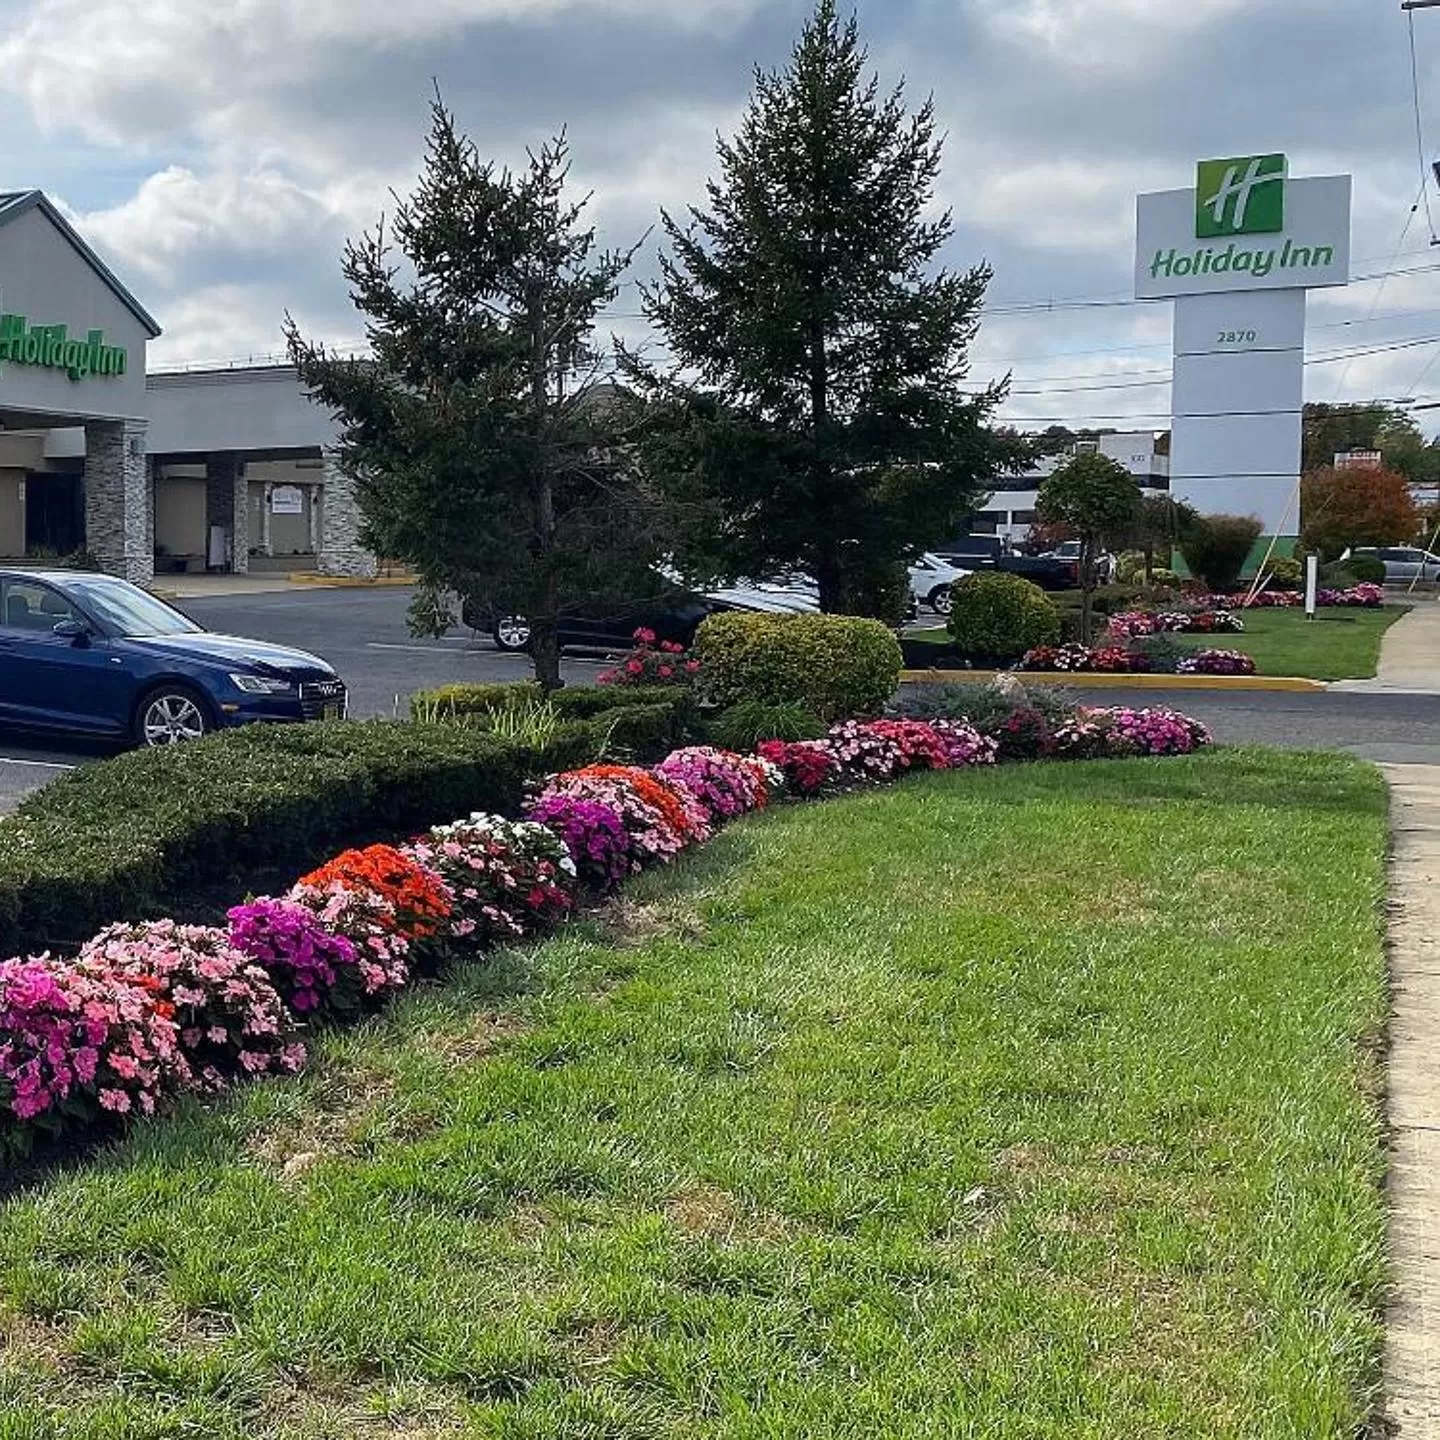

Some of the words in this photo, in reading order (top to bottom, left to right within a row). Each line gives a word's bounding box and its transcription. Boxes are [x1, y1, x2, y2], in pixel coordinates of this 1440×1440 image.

[1149, 243, 1276, 279] Holiday
[1279, 239, 1334, 268] Inn
[0, 313, 93, 381] Holiday
[88, 329, 127, 376] Inn
[1216, 330, 1257, 343] 2870
